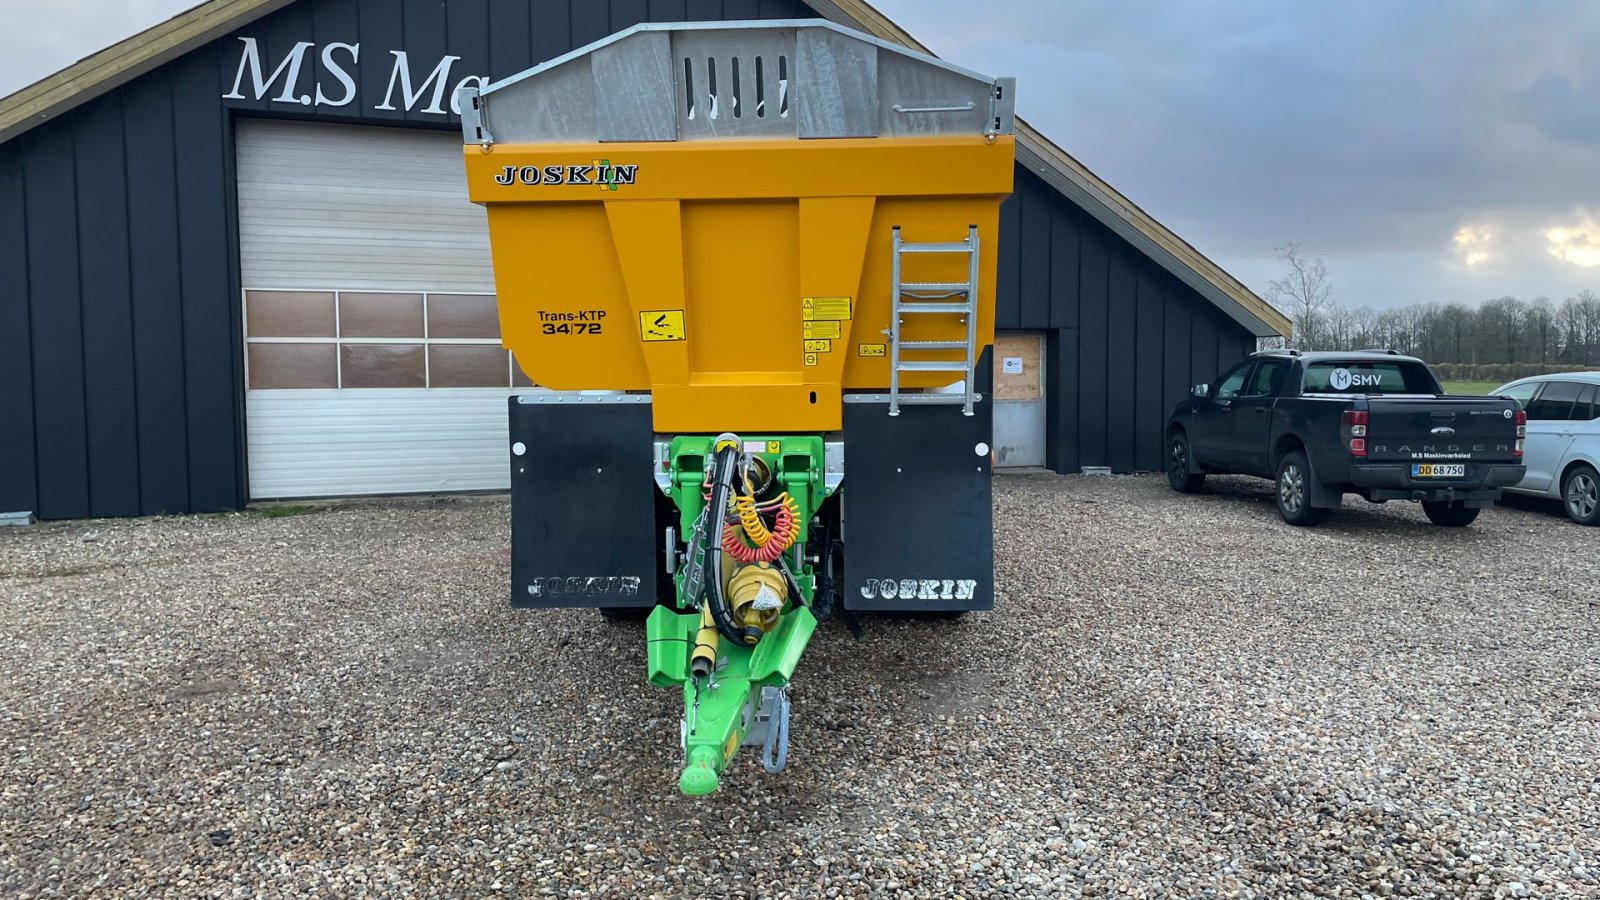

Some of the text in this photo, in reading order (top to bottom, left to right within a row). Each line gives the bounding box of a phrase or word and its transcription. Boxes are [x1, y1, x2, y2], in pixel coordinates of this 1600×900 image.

[222, 37, 359, 106] M.S
[494, 164, 638, 186] JOSKIN
[537, 310, 607, 321] Trans-KTP
[542, 323, 602, 336] 34/72
[1352, 374, 1382, 386] SMV
[1374, 444, 1508, 453] RANGER
[1418, 464, 1464, 475] DD 68 750
[860, 578, 977, 600] JOSKIN
